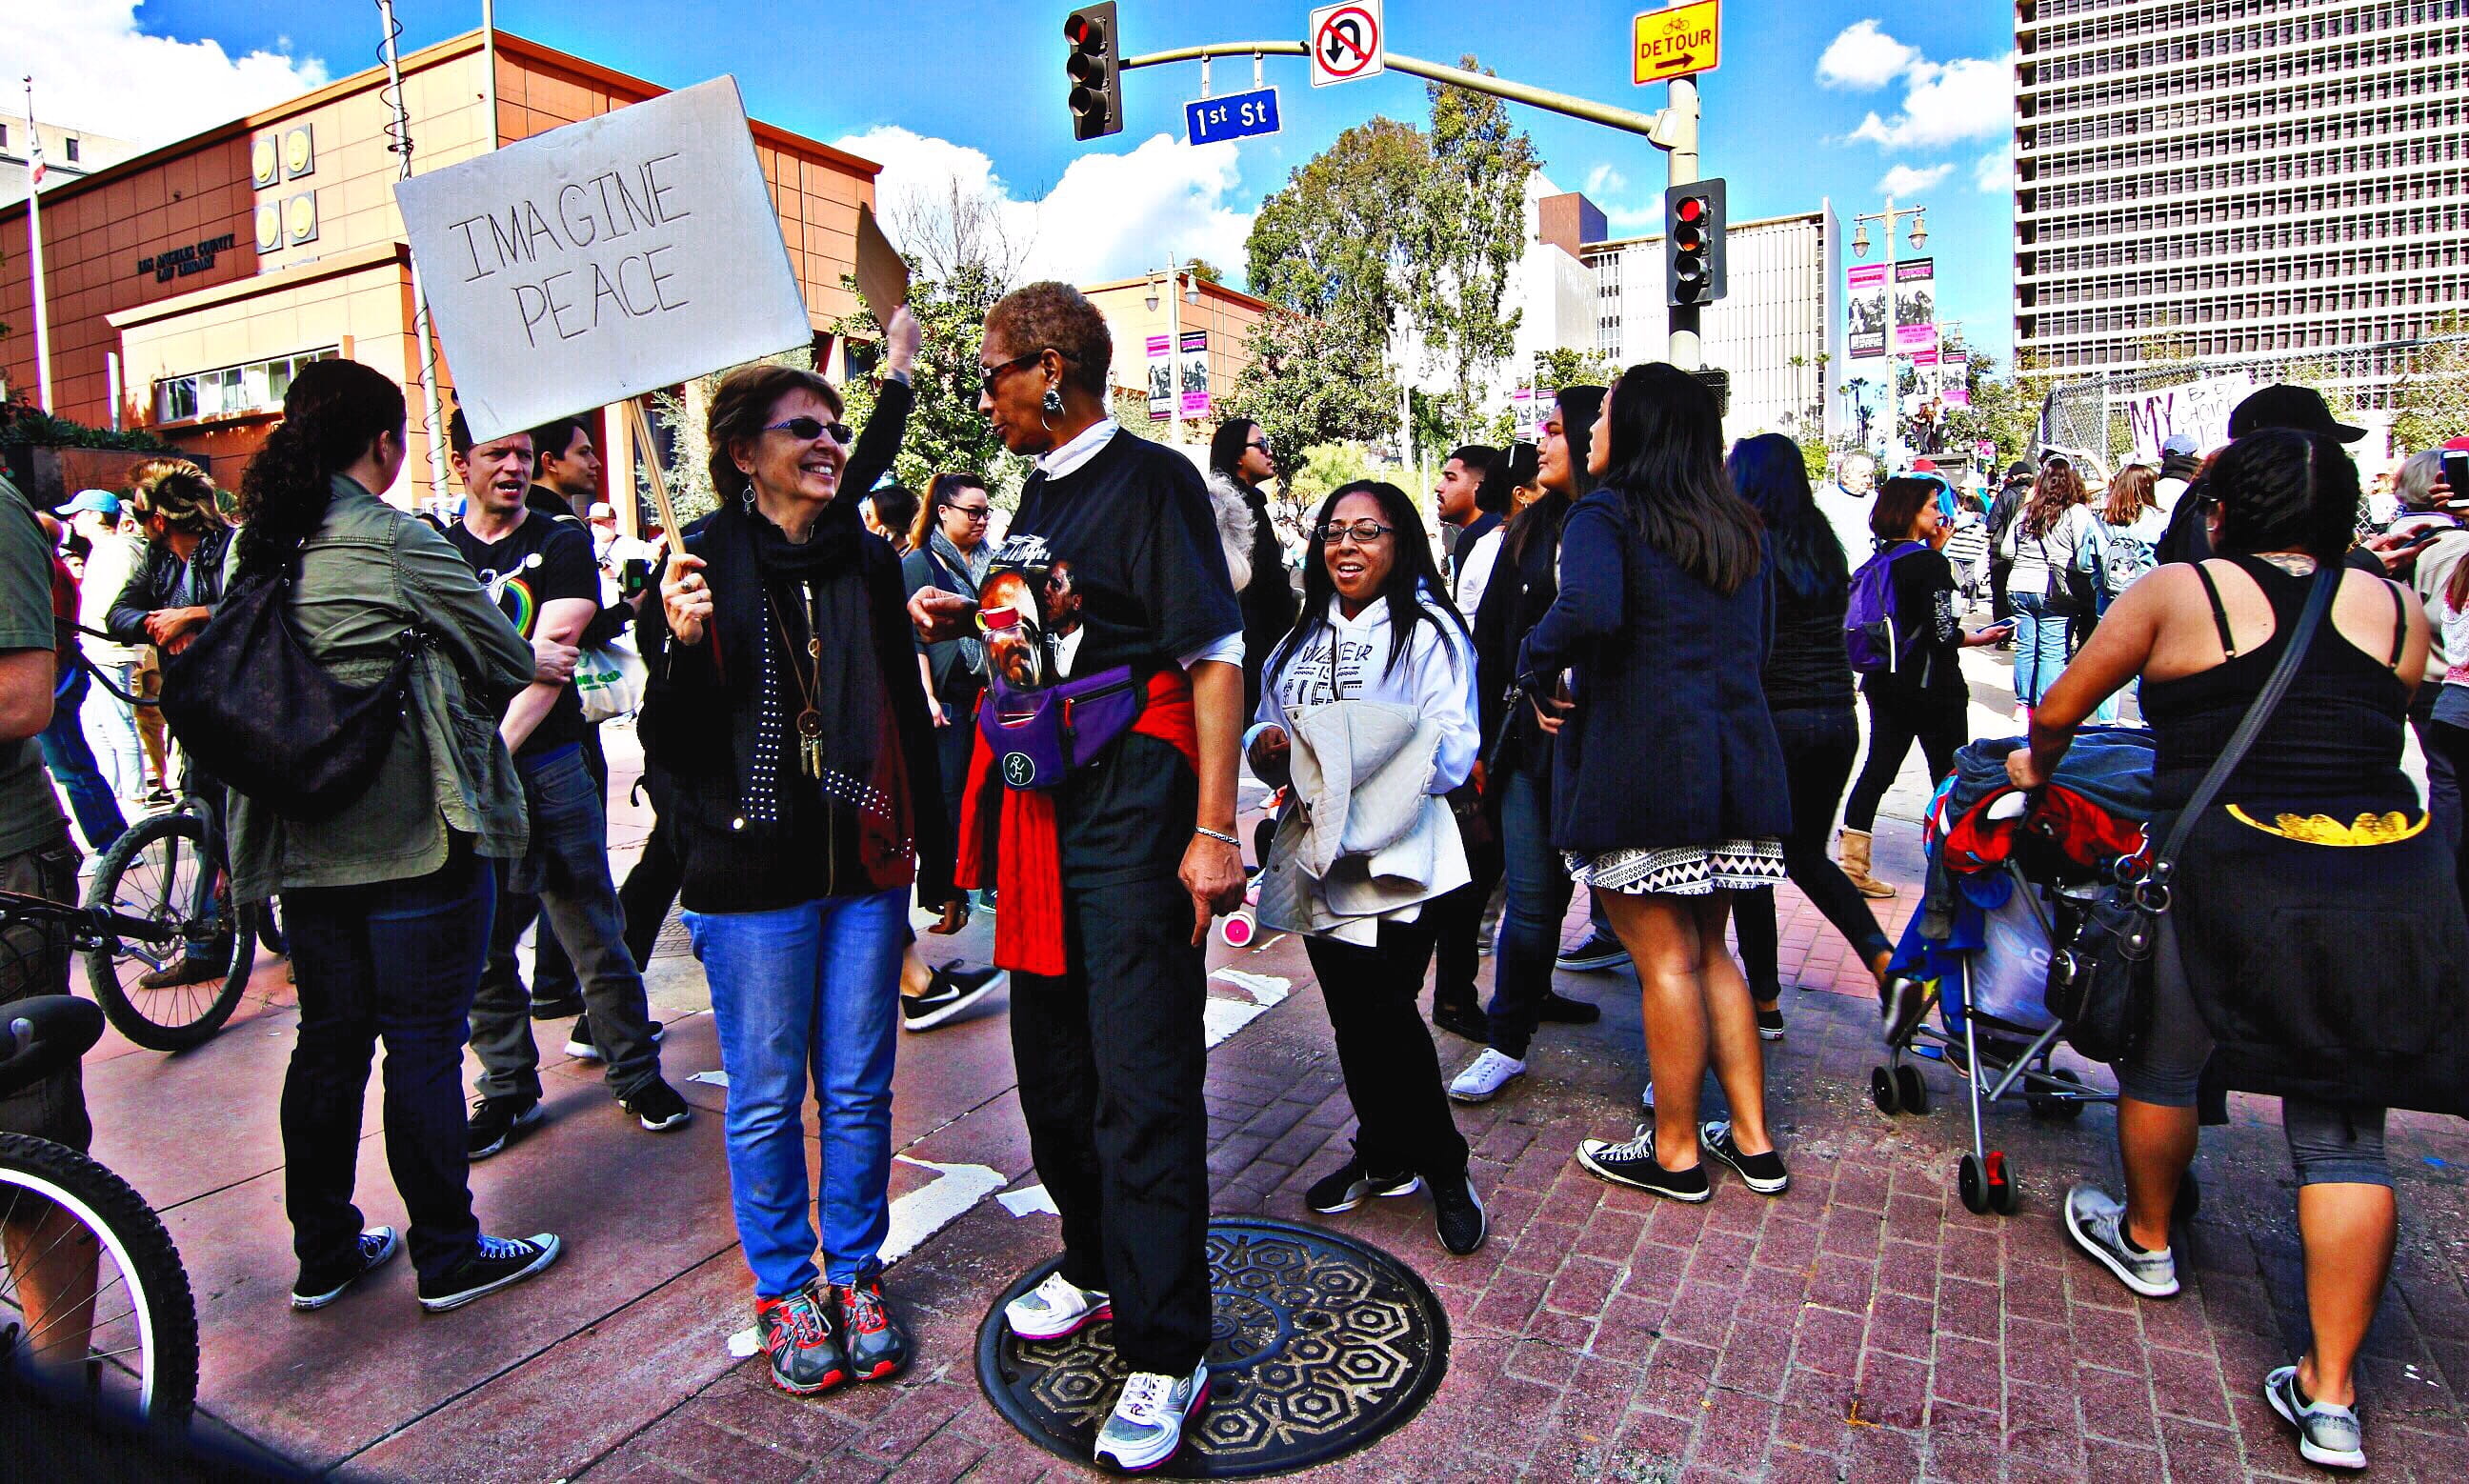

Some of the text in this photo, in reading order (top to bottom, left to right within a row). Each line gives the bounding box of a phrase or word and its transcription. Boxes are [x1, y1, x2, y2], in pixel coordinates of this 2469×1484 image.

[1641, 29, 1712, 59] DETOUR
[1196, 100, 1267, 137] 1st St
[449, 152, 691, 282] IMAGINE
[137, 233, 235, 275] LOS ANGELES COUNTY
[156, 254, 215, 284] LAW LIBRARY
[511, 245, 690, 349] PEACE
[2130, 392, 2174, 459] MY
